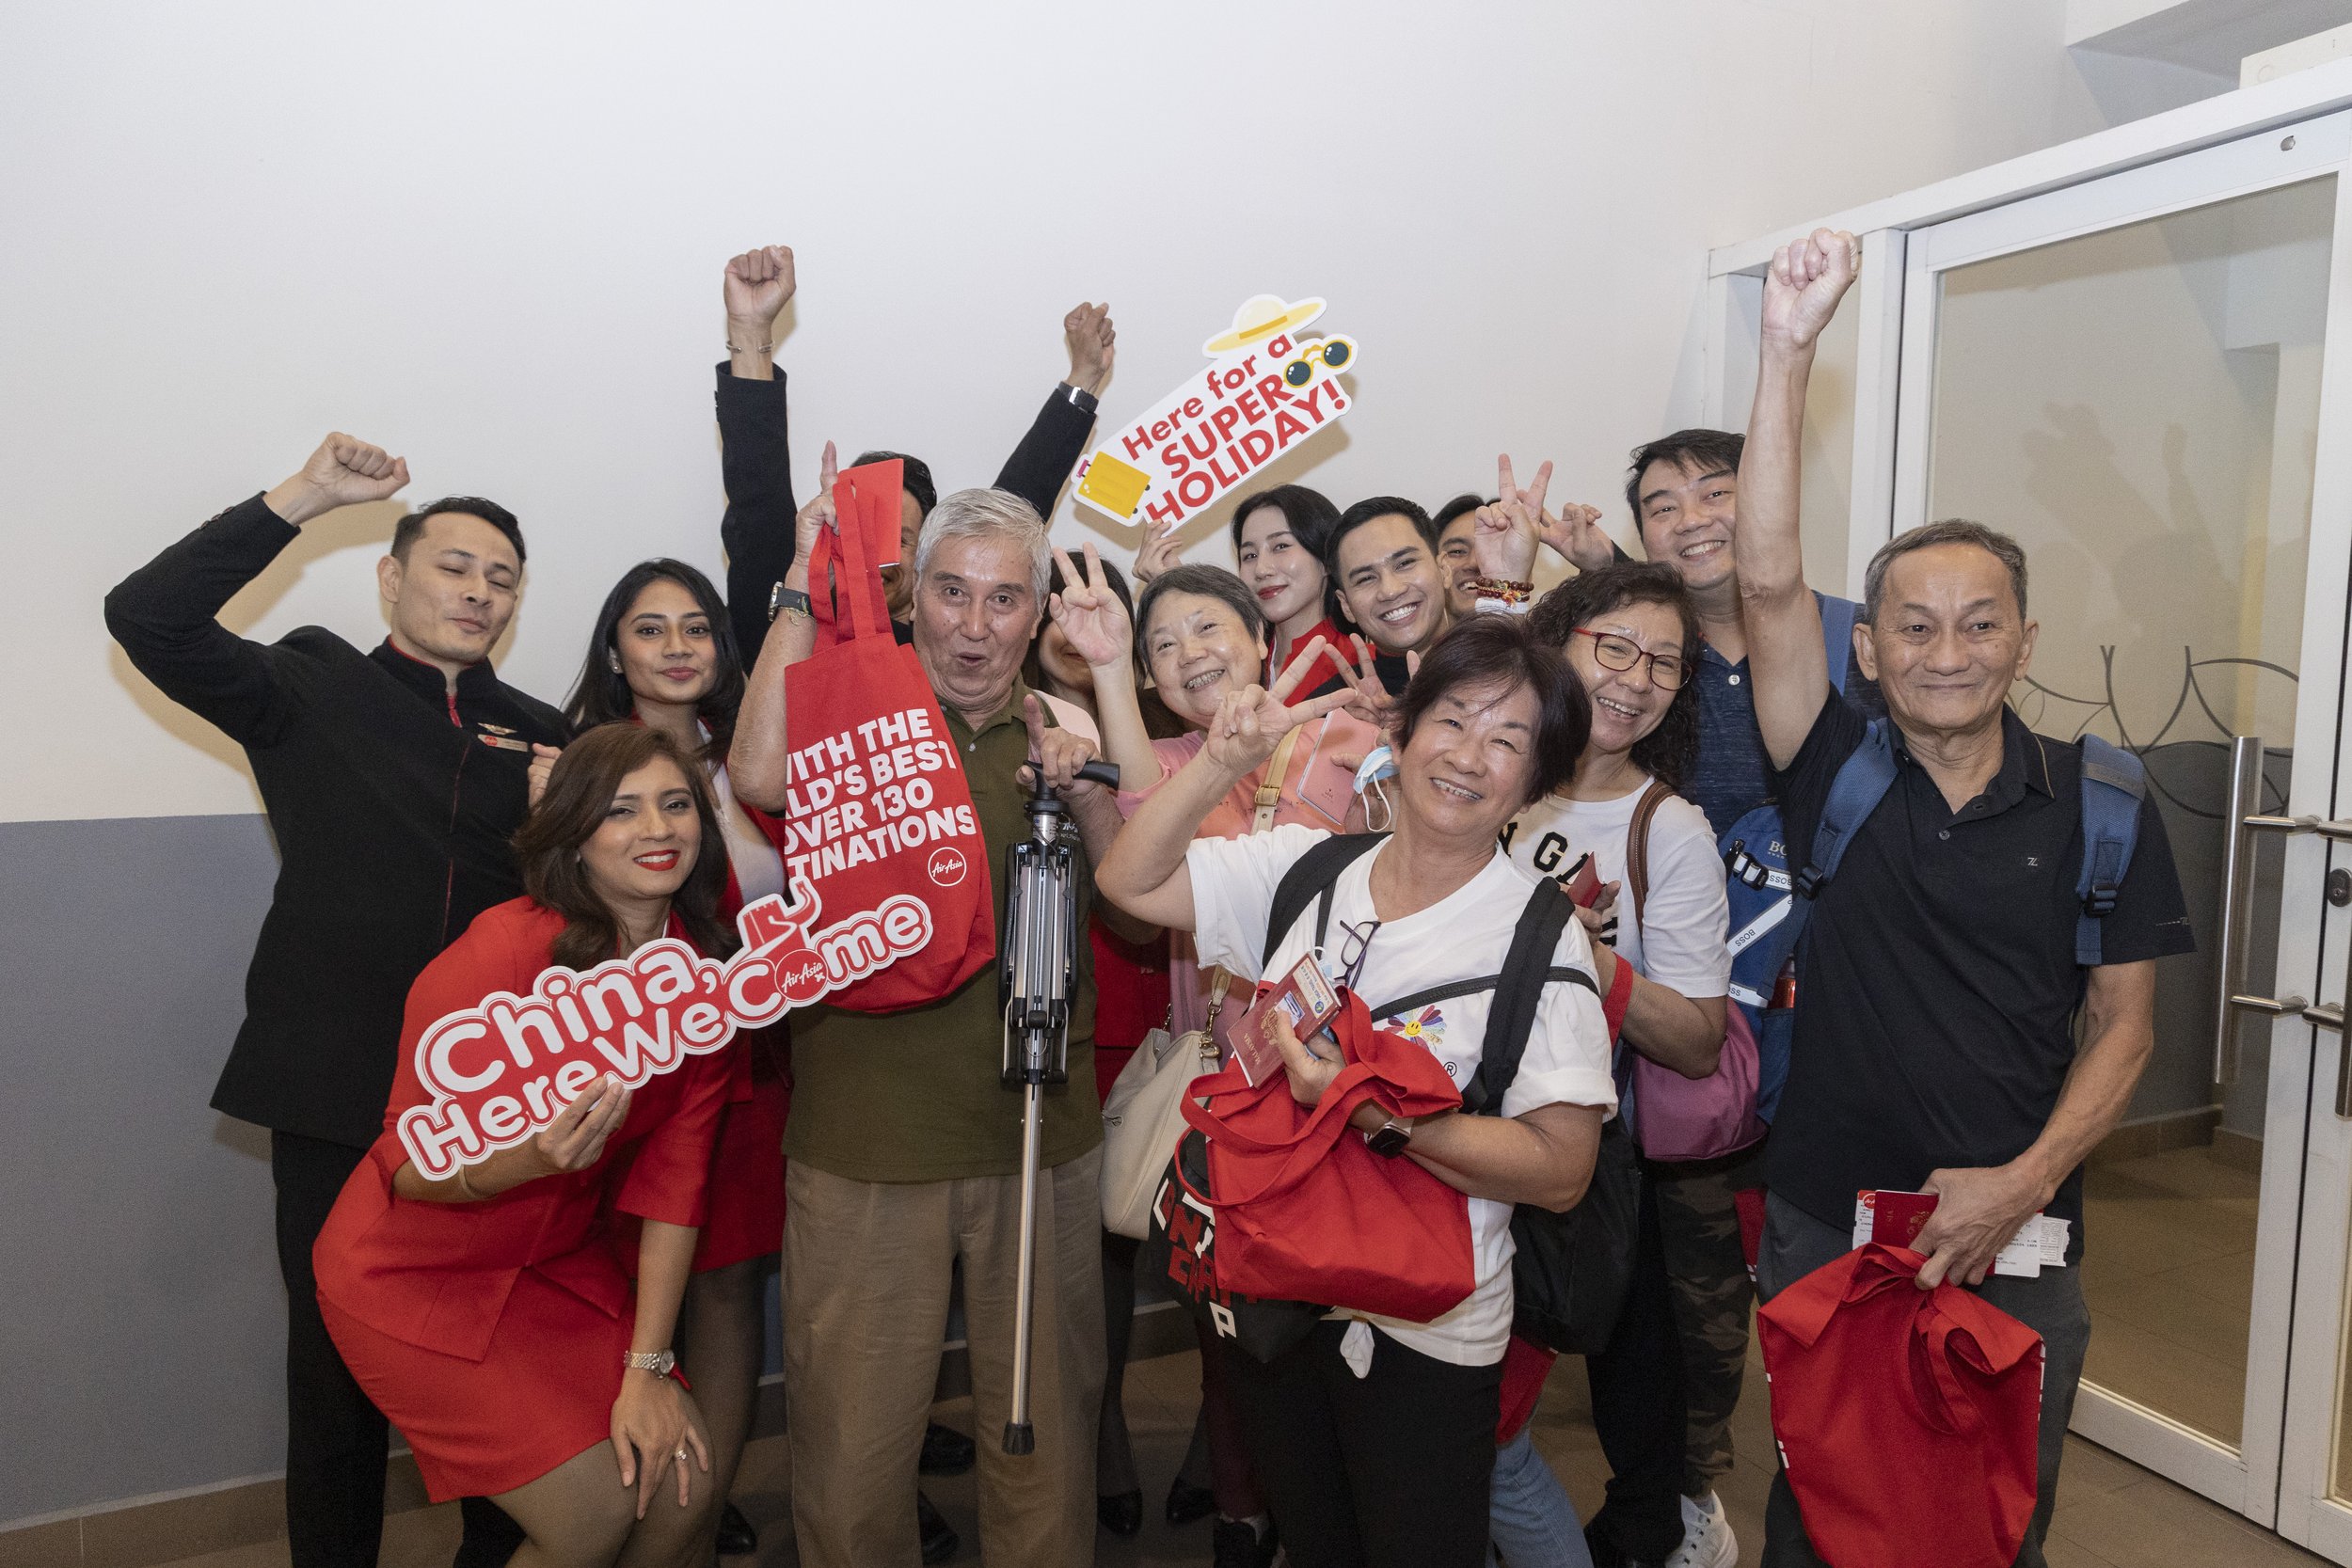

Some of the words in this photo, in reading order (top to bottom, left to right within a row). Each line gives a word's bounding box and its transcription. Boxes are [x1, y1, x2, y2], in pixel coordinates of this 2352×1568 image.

[1121, 397, 1204, 461] Here
[1206, 355, 1257, 400] for
[1267, 334, 1294, 359] a
[1160, 373, 1295, 480] SUPER
[1145, 379, 1346, 524] HOLIDAY!
[786, 731, 856, 784] ITH
[857, 708, 933, 753] THE
[785, 764, 867, 820] LD'S
[871, 778, 933, 822] 130
[931, 858, 963, 878] AirAsia
[1735, 928, 1756, 947] BOSS
[781, 961, 823, 994] AirAsia
[430, 945, 718, 1093] China,
